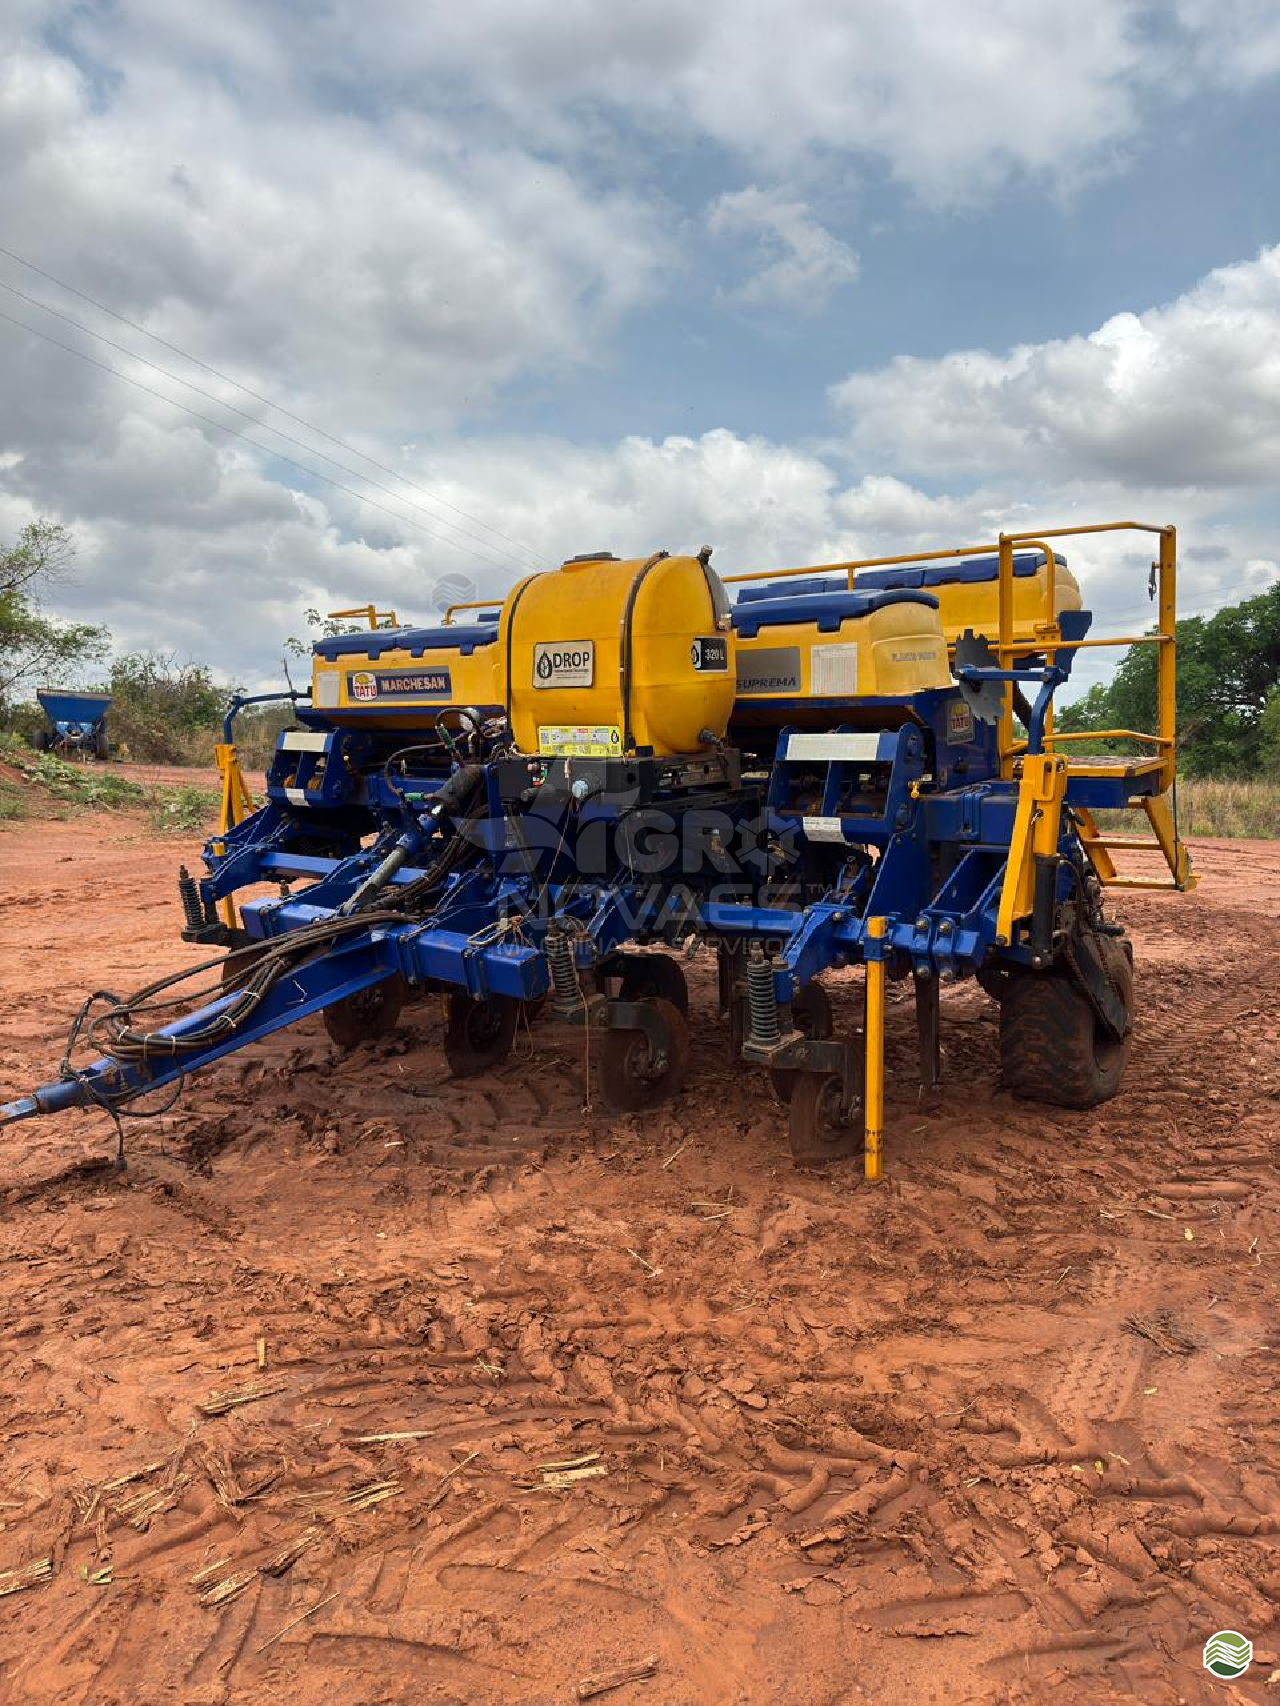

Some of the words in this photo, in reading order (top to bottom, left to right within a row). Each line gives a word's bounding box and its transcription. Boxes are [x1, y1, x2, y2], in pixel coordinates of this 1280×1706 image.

[552, 652, 590, 668] DROP
[381, 676, 446, 692] MARCHESAN
[736, 677, 797, 690] SUPREMA
[355, 685, 377, 698] TATU
